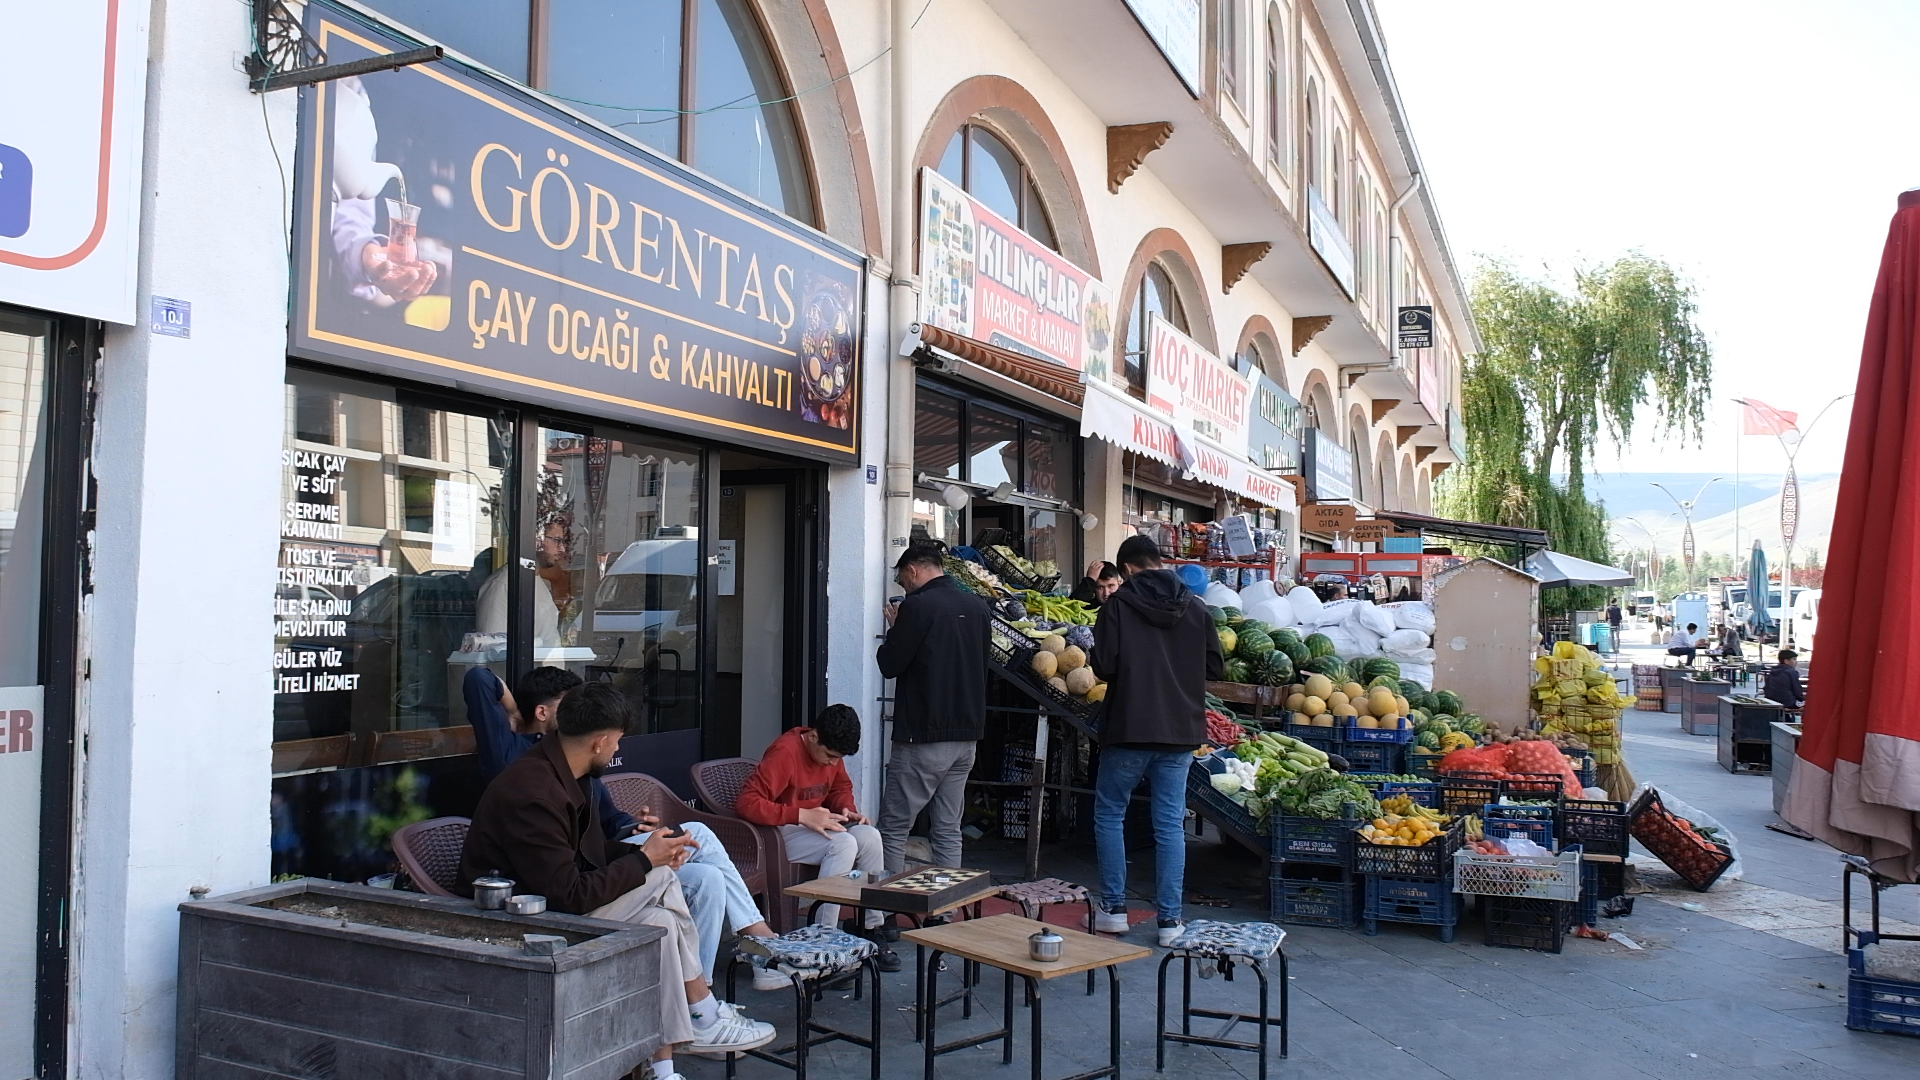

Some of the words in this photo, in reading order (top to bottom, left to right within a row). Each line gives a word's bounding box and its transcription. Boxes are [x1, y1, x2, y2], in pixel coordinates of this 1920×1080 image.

[470, 142, 796, 345] GÖRENTAŞ
[979, 222, 1080, 325] KILINÇLAR
[161, 309, 183, 325] 10J
[982, 287, 1029, 337] MARKET
[1030, 317, 1038, 343] &
[1040, 318, 1076, 359] MANAV
[467, 279, 537, 350] ÇAY
[547, 305, 640, 375] OCAĞI
[649, 333, 671, 382] &
[681, 343, 793, 412] KAHVALTI
[1153, 325, 1189, 406] KOÇ
[1192, 353, 1248, 426] MARKET
[282, 449, 321, 469] SICAK
[323, 455, 347, 476] ÇAY
[1195, 446, 1230, 480] ANAV
[291, 474, 309, 492] VE
[311, 473, 337, 495] SÜT
[286, 501, 340, 522] SERPME
[281, 519, 343, 540] KAHVALTI
[1319, 519, 1340, 528] GIDA
[285, 547, 318, 565] TOST
[319, 549, 337, 566] VE
[277, 567, 354, 589] TIŞTIRMALIK
[300, 599, 352, 616] SALONU
[273, 648, 317, 669] GÜLER
[319, 647, 342, 667] YÜZ
[314, 671, 361, 692] HİZMET
